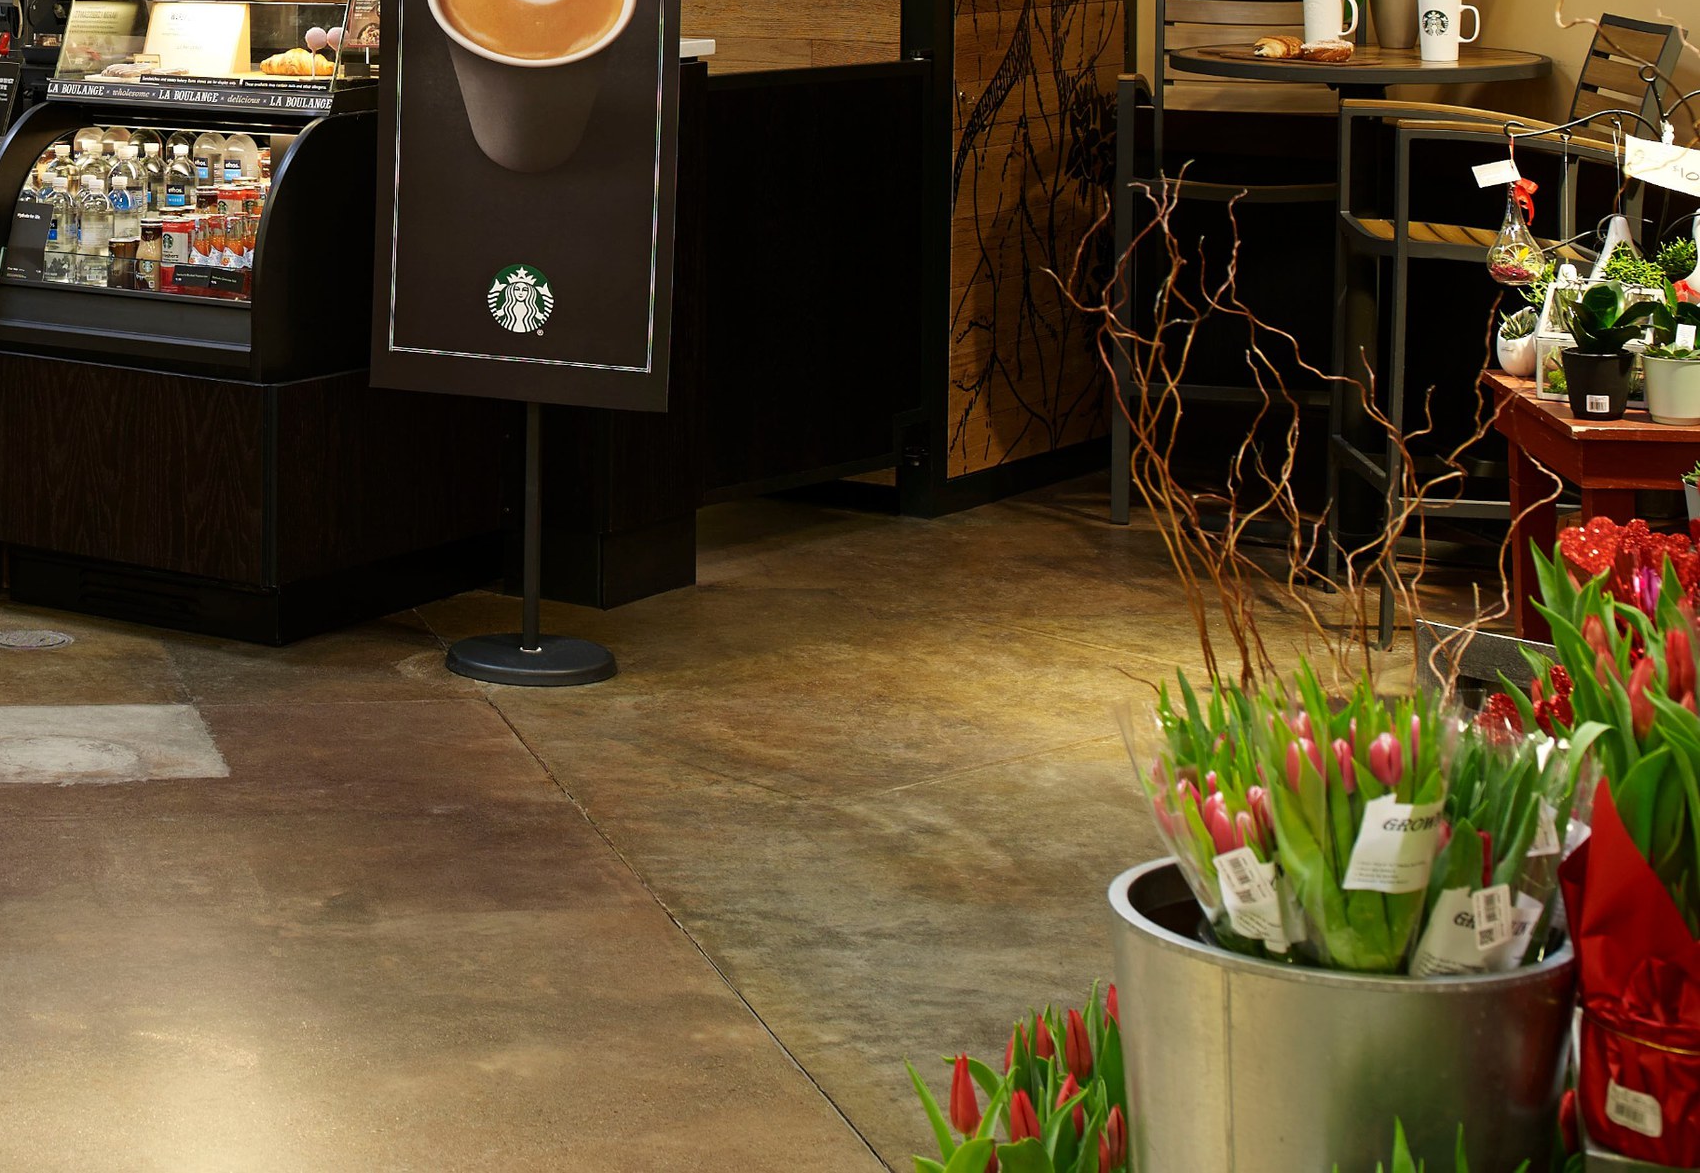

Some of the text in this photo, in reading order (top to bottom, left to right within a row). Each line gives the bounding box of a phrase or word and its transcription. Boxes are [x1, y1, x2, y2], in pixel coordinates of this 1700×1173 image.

[47, 82, 333, 109] LA BOULANGE wholesome LA BOULANGE delicious LA BOULANGE
[1383, 811, 1443, 832] GROW
